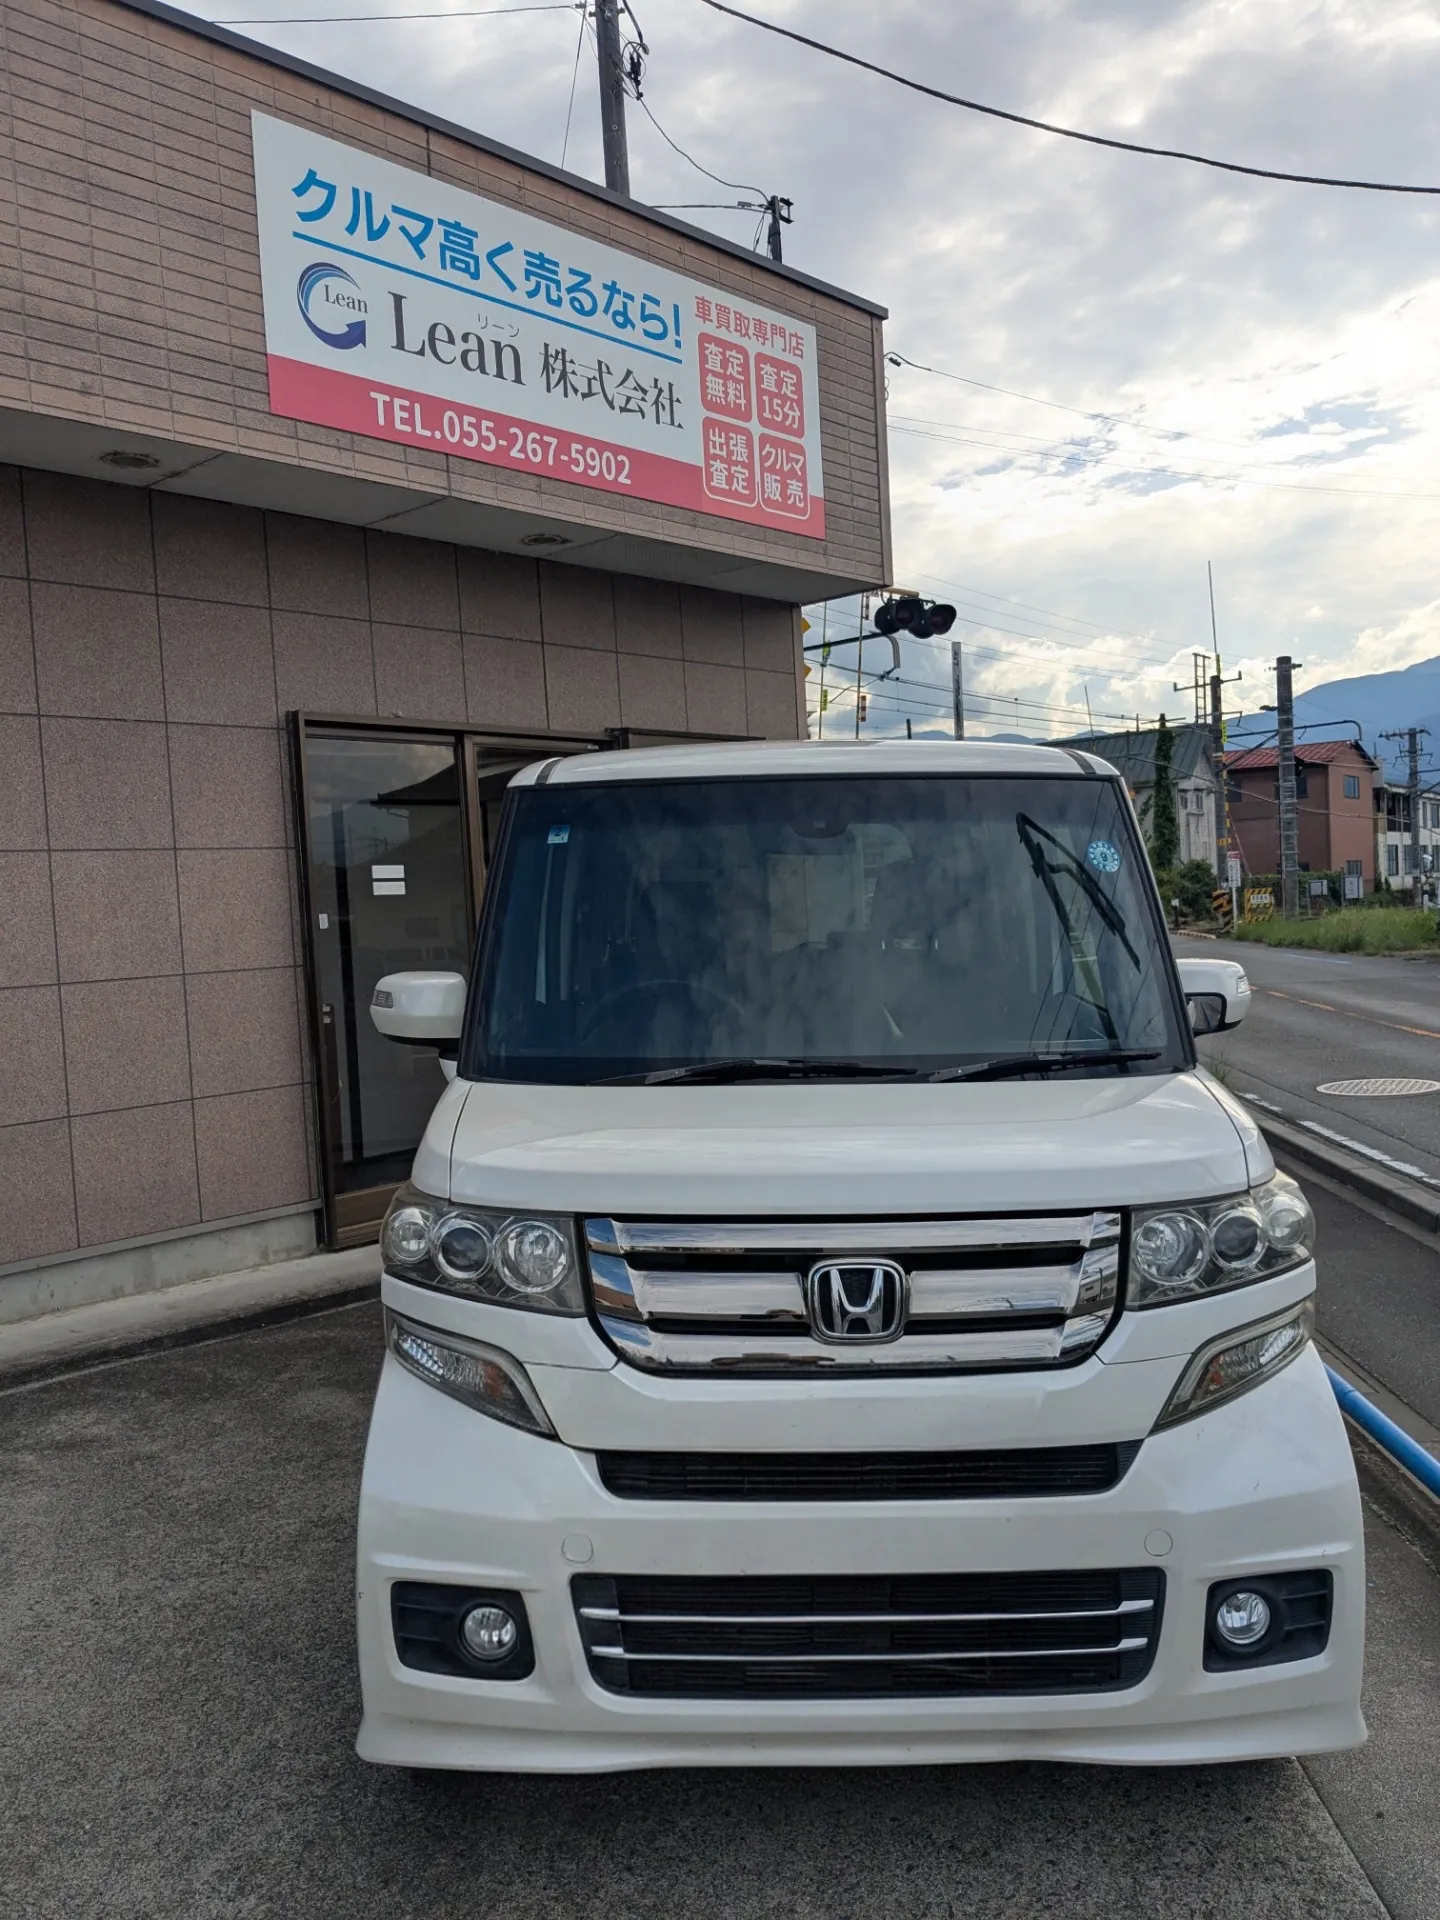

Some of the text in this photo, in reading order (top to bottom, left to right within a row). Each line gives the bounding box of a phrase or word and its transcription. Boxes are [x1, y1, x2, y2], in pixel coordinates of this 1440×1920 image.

[291, 168, 682, 349] クルマ高く売るなら!
[324, 284, 369, 314] Lean
[477, 313, 520, 338] リーン
[694, 296, 805, 360] 車買取専門店
[388, 290, 685, 430] Lean 株式会社
[704, 342, 745, 381] 査定
[706, 374, 747, 412] 無料
[760, 362, 798, 399] 査定
[762, 395, 801, 430] 15分
[369, 391, 632, 485] TEL.055-267-5902
[709, 427, 749, 464] 出張
[709, 459, 750, 495] 査定
[761, 443, 805, 476] クルマ
[764, 472, 805, 508] 販売
